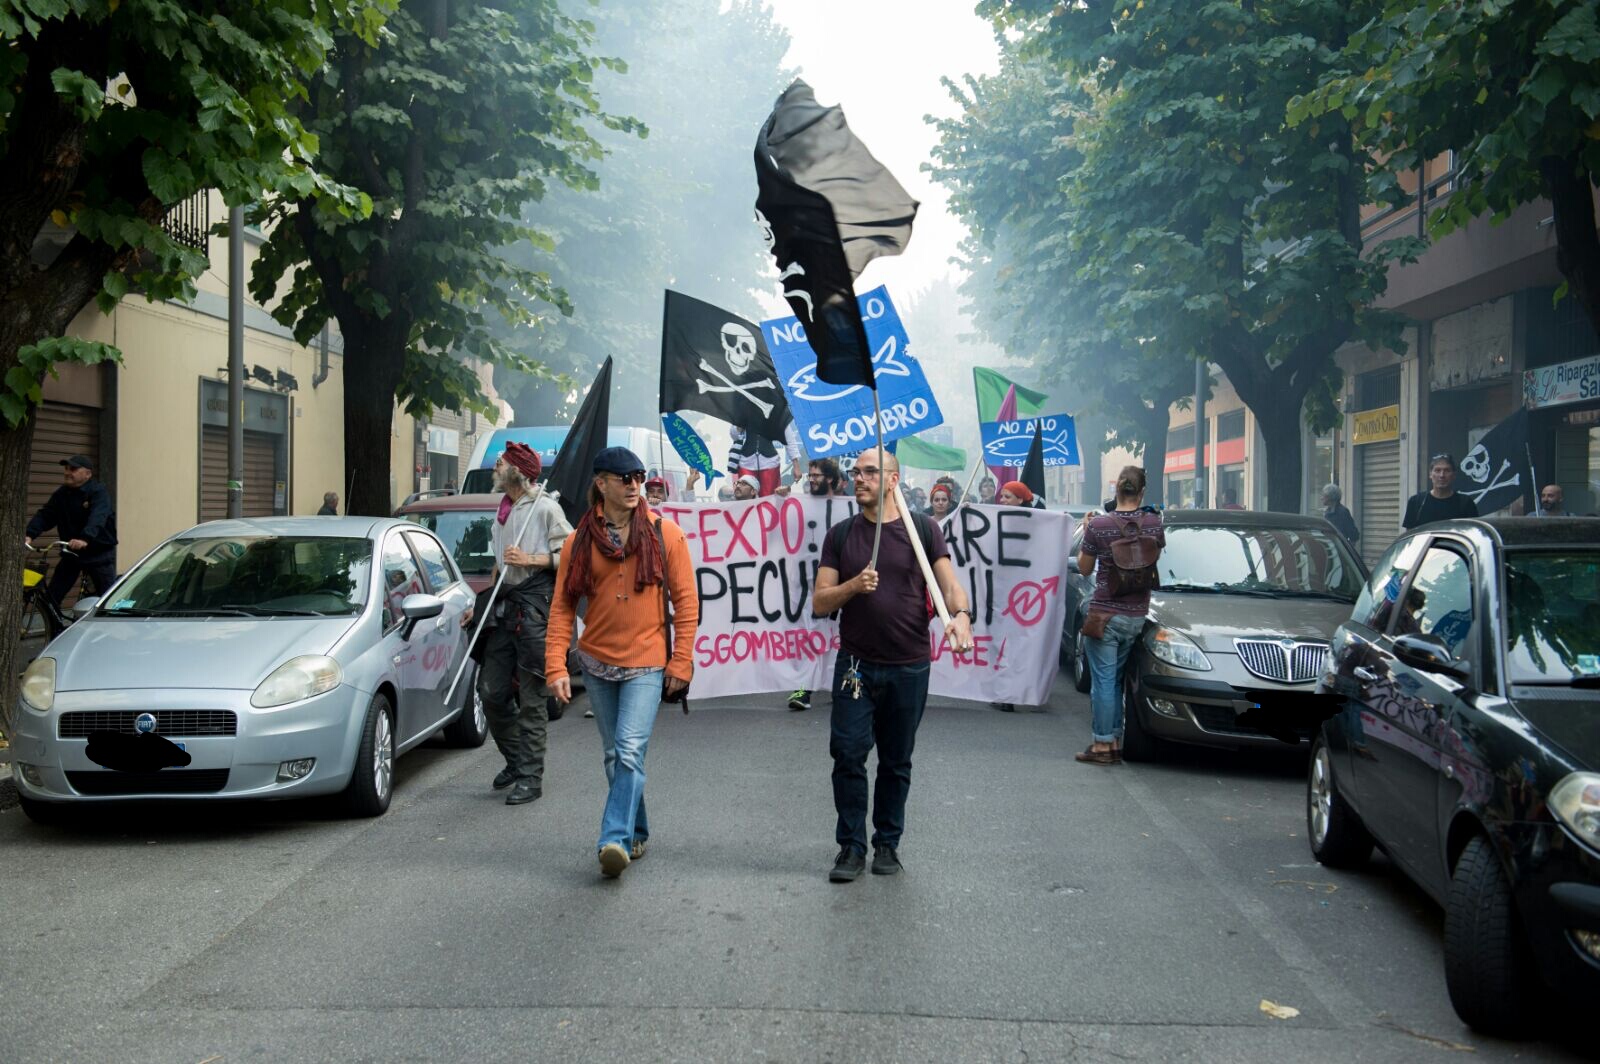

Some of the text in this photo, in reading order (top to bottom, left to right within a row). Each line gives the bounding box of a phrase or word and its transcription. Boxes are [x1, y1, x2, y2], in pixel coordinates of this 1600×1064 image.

[808, 397, 929, 453] SGOMBRO
[998, 421, 1020, 435] NO
[1003, 457, 1067, 467] SGBRO
[943, 507, 1032, 567] ARE
[694, 628, 827, 668] SGOMBERO
